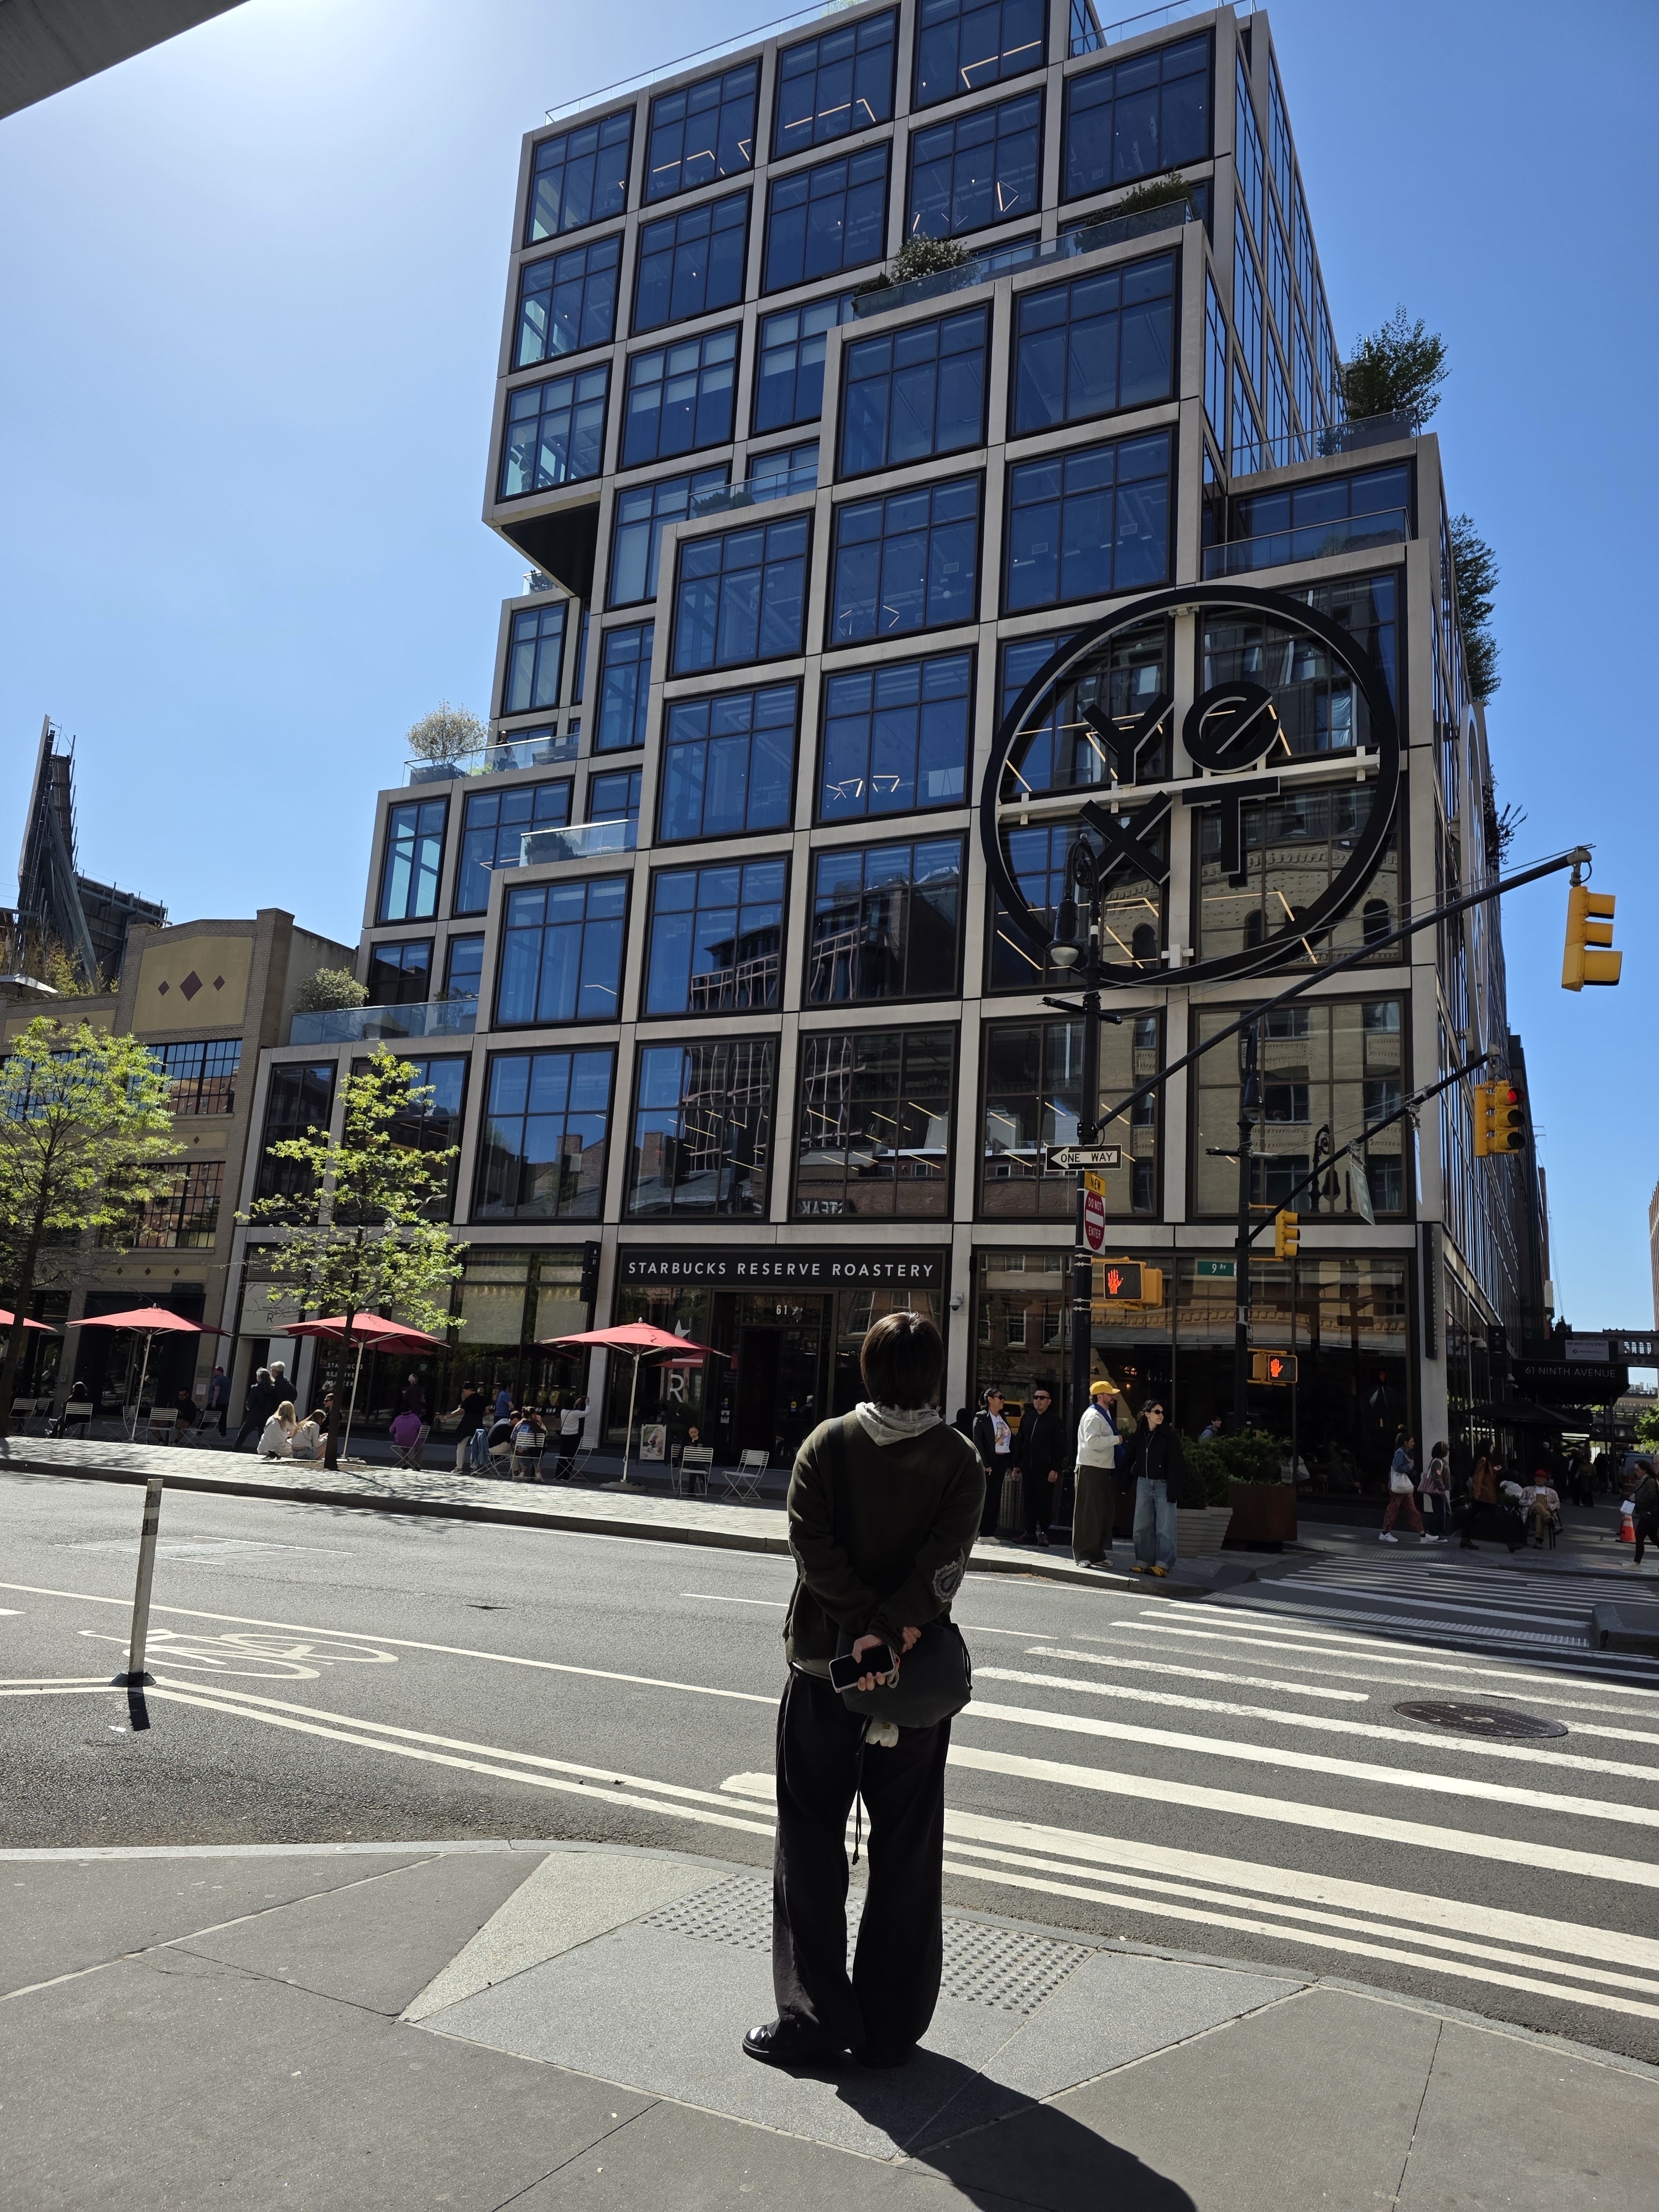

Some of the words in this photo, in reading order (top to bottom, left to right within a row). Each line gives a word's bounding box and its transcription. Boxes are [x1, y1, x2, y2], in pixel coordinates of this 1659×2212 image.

[1061, 1153, 1081, 1163] ONE
[1091, 1152, 1113, 1162] WAY
[1091, 1176, 1101, 1192] NEW
[1088, 1197, 1094, 1208] DO
[1088, 1225, 1101, 1239] ENTER
[628, 1262, 726, 1275] STARBUCKS
[737, 1262, 820, 1275] RESERVE
[832, 1264, 933, 1277] ROASTERY
[1212, 1263, 1217, 1274] 9
[776, 1305, 787, 1315] 61
[267, 1312, 274, 1323] R
[1525, 1366, 1535, 1375] 61
[1538, 1366, 1571, 1376] NINTH
[1574, 1368, 1616, 1378] AVENUE
